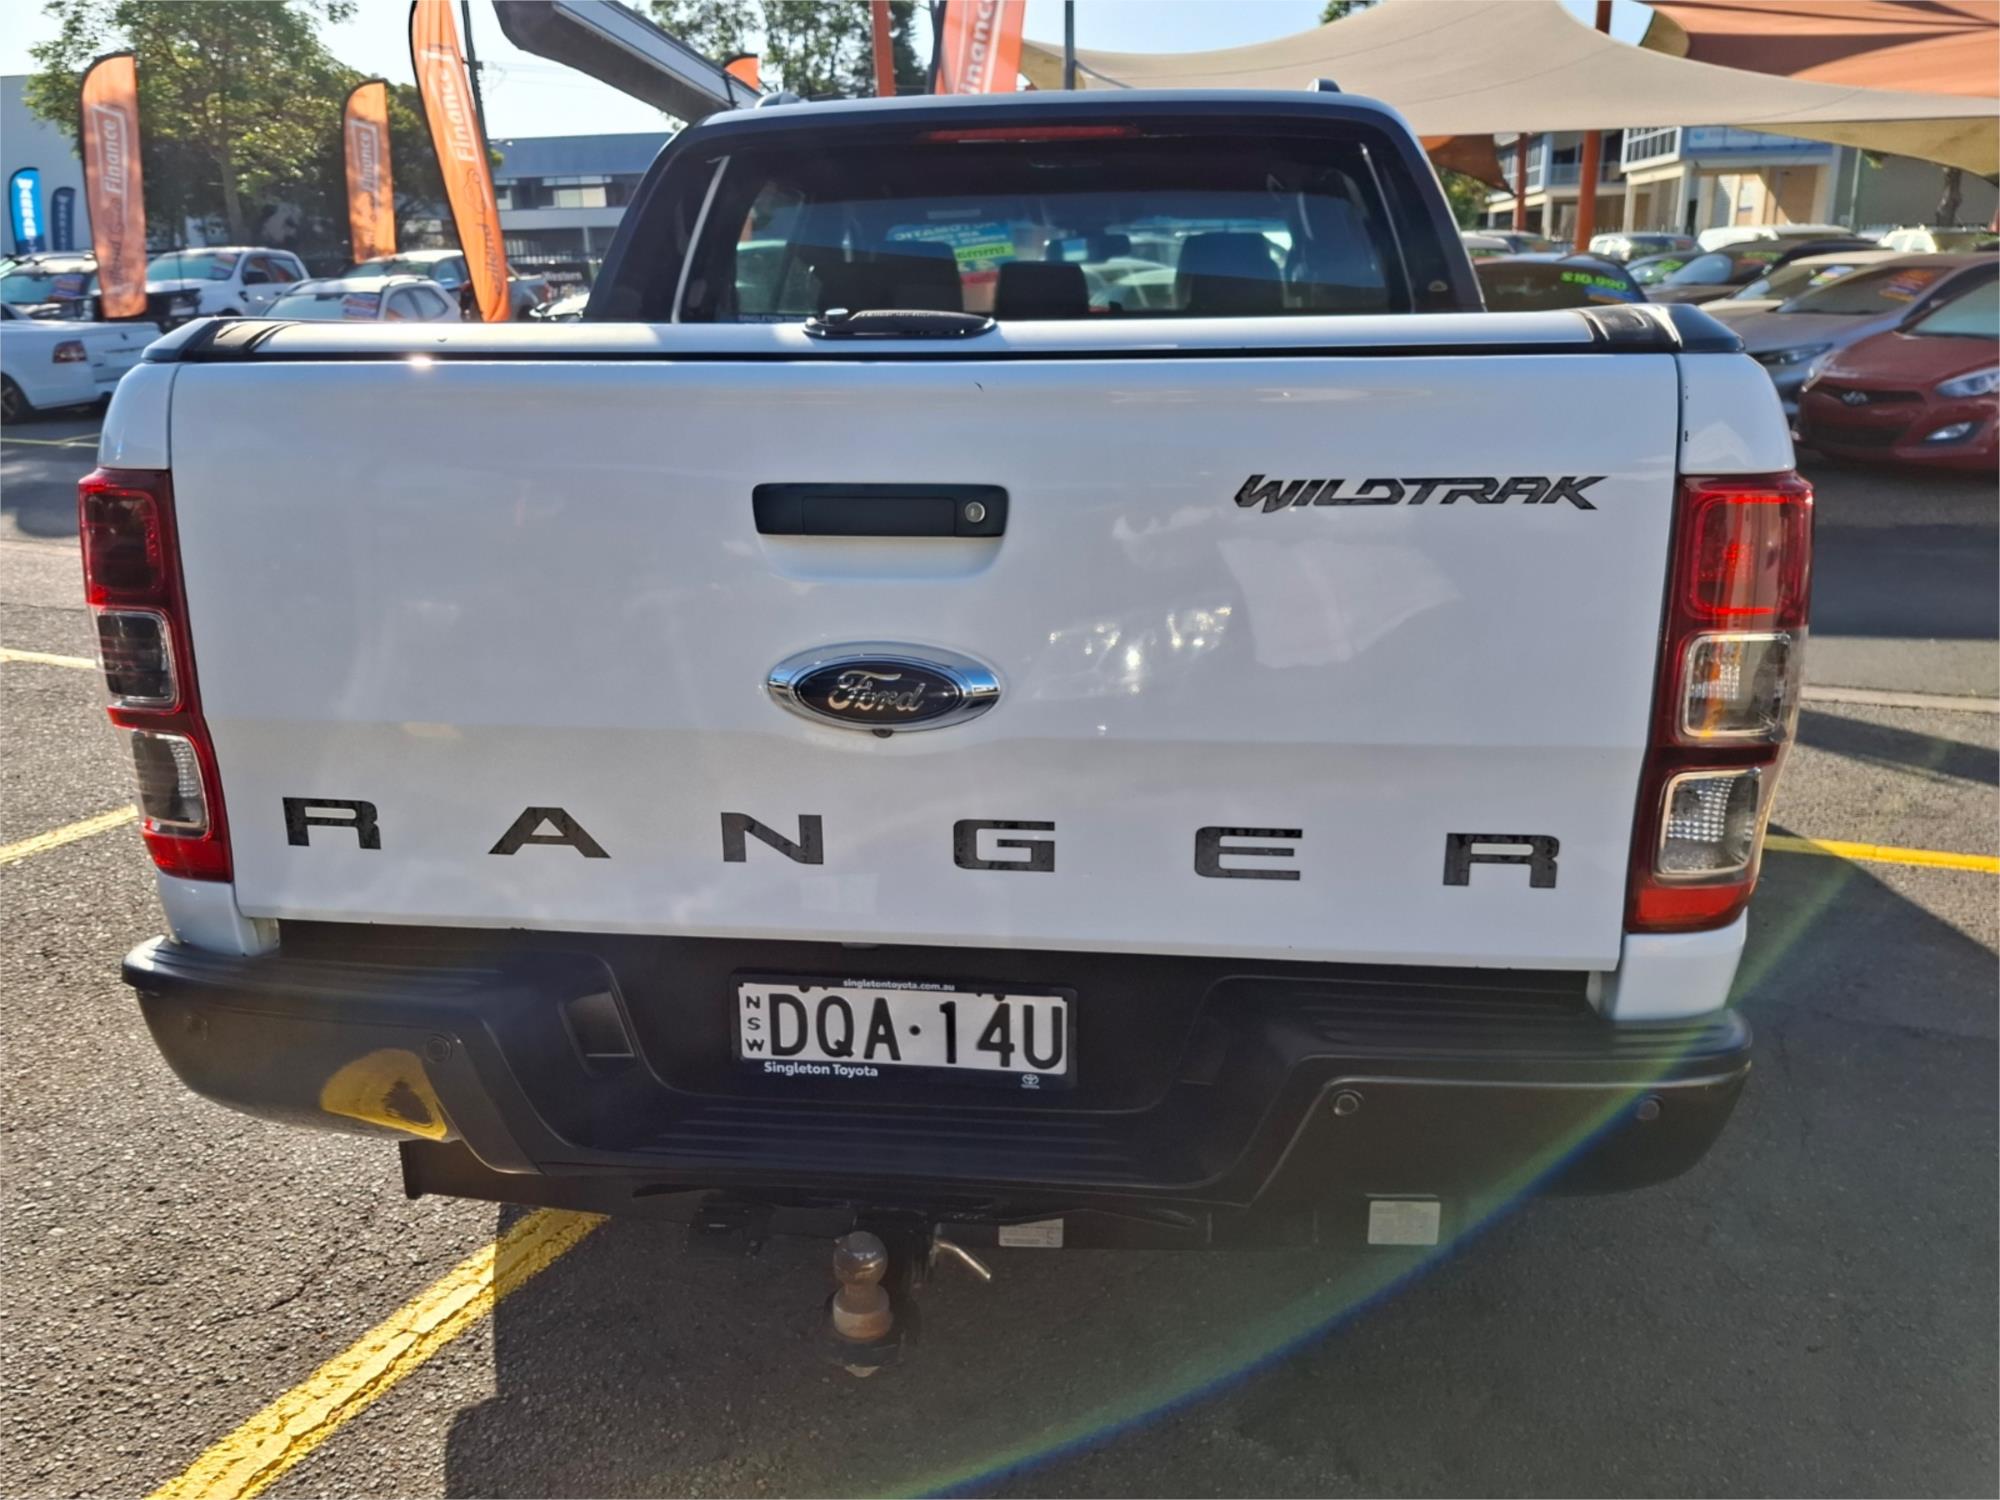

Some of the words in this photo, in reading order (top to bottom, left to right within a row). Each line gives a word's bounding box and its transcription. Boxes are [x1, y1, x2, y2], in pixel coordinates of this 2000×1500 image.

[960, 0, 996, 95] inanc
[438, 68, 476, 163] Finance
[103, 119, 122, 194] Finance
[358, 130, 377, 193] Finance
[1234, 474, 1609, 513] WILDTRAK
[827, 670, 926, 711] Ford
[282, 797, 1561, 889] RANGER
[843, 978, 955, 992] singletontoyota.com.au
[763, 1061, 831, 1076] Singleton
[832, 1064, 879, 1078] Toyota
